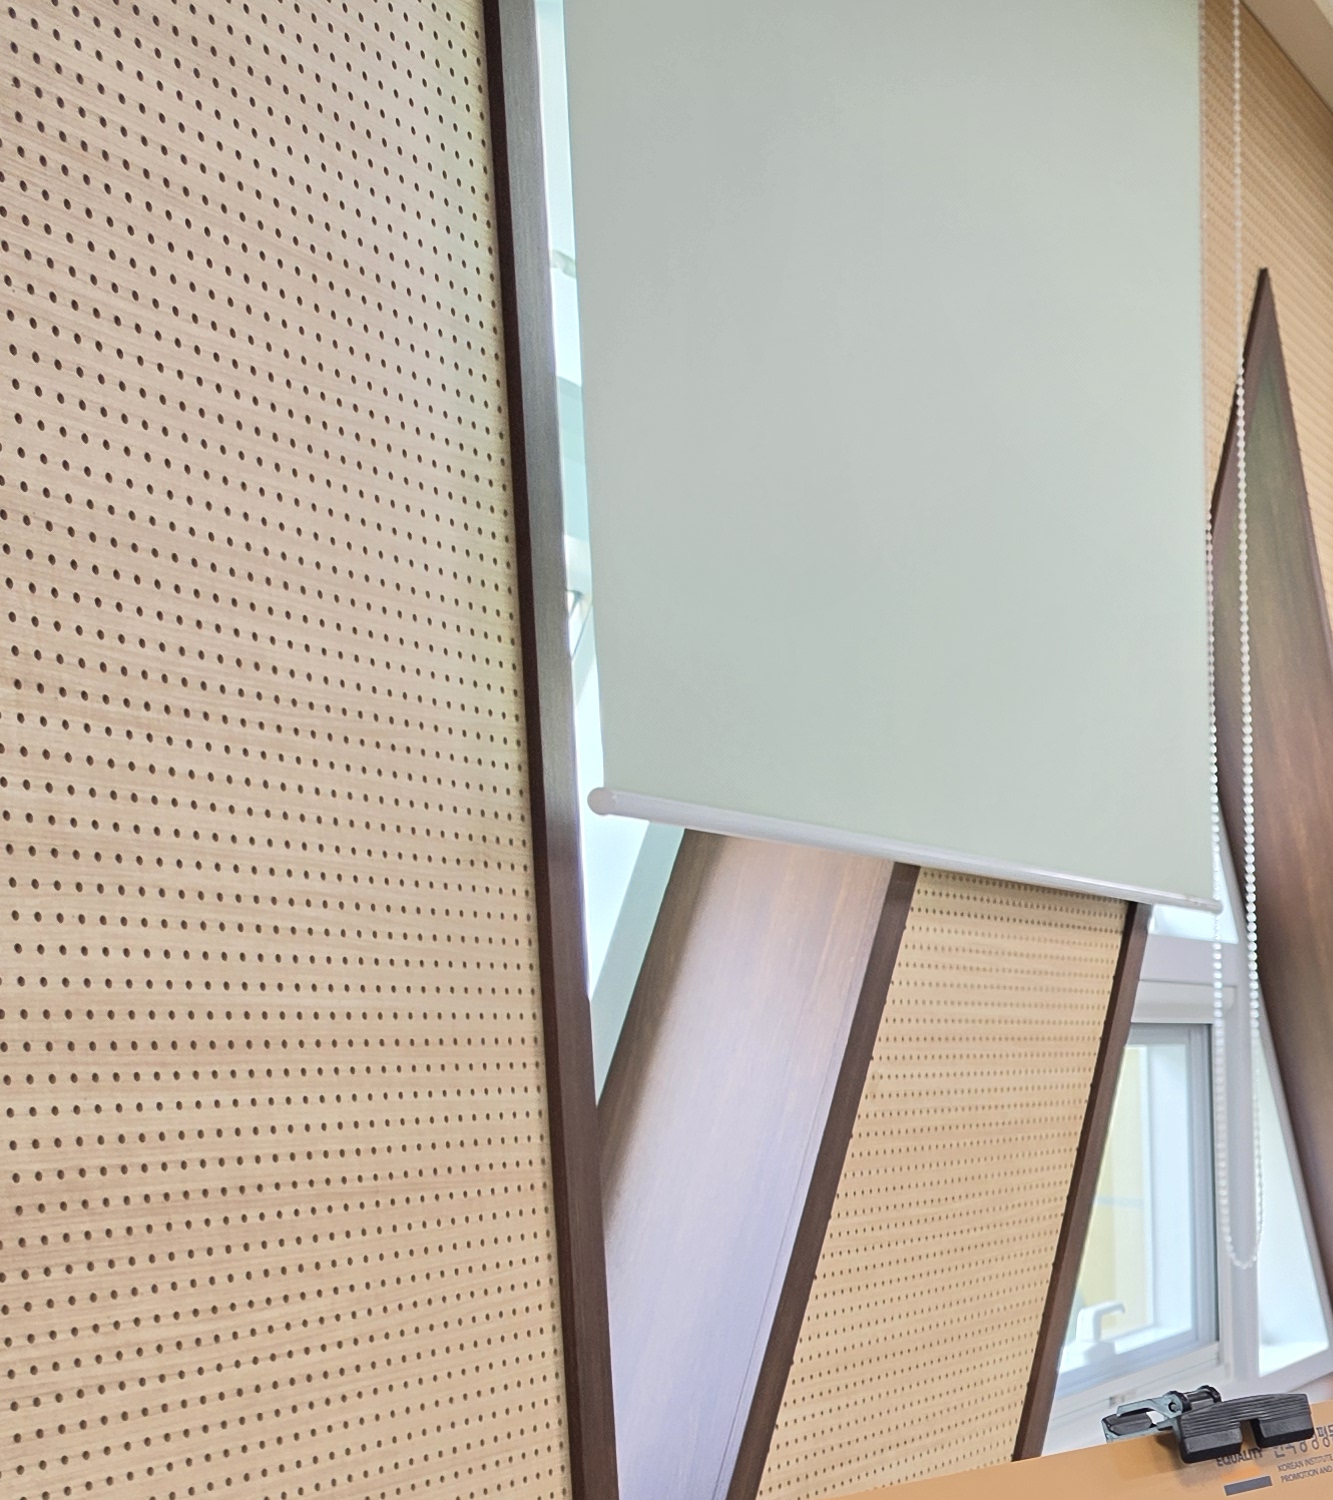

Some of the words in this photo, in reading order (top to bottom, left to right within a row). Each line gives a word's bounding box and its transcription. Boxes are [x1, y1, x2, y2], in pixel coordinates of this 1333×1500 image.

[1216, 1448, 1263, 1467] EQUALITY
[1278, 1460, 1303, 1472] KOREAN
[1303, 1454, 1333, 1467] INSTITUTE
[1281, 1468, 1319, 1483] PROMOTION
[1320, 1465, 1332, 1474] AND
